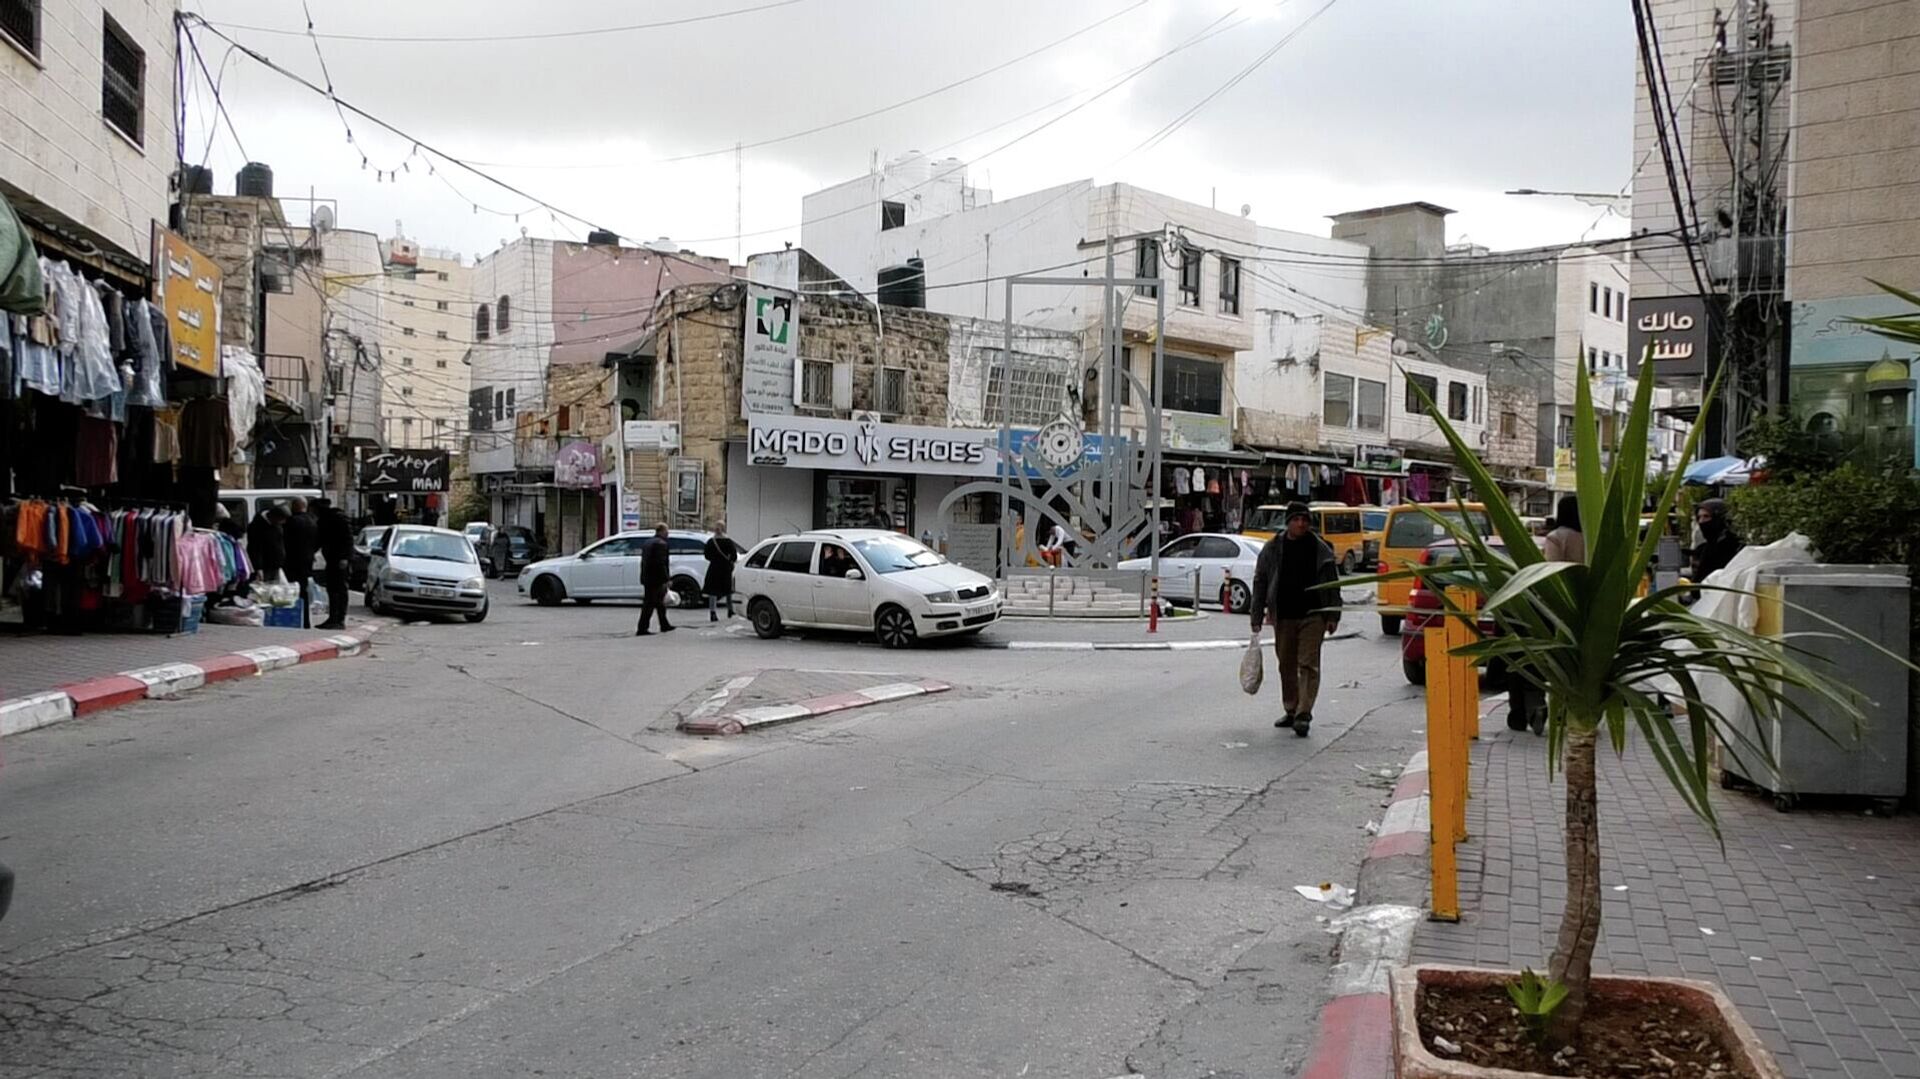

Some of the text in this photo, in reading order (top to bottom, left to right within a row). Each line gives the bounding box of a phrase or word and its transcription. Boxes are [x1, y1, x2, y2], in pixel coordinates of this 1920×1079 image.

[1637, 311, 1694, 332] مالك
[752, 427, 848, 456] MADO
[888, 436, 985, 464] SHOES
[412, 477, 443, 491] MAN
